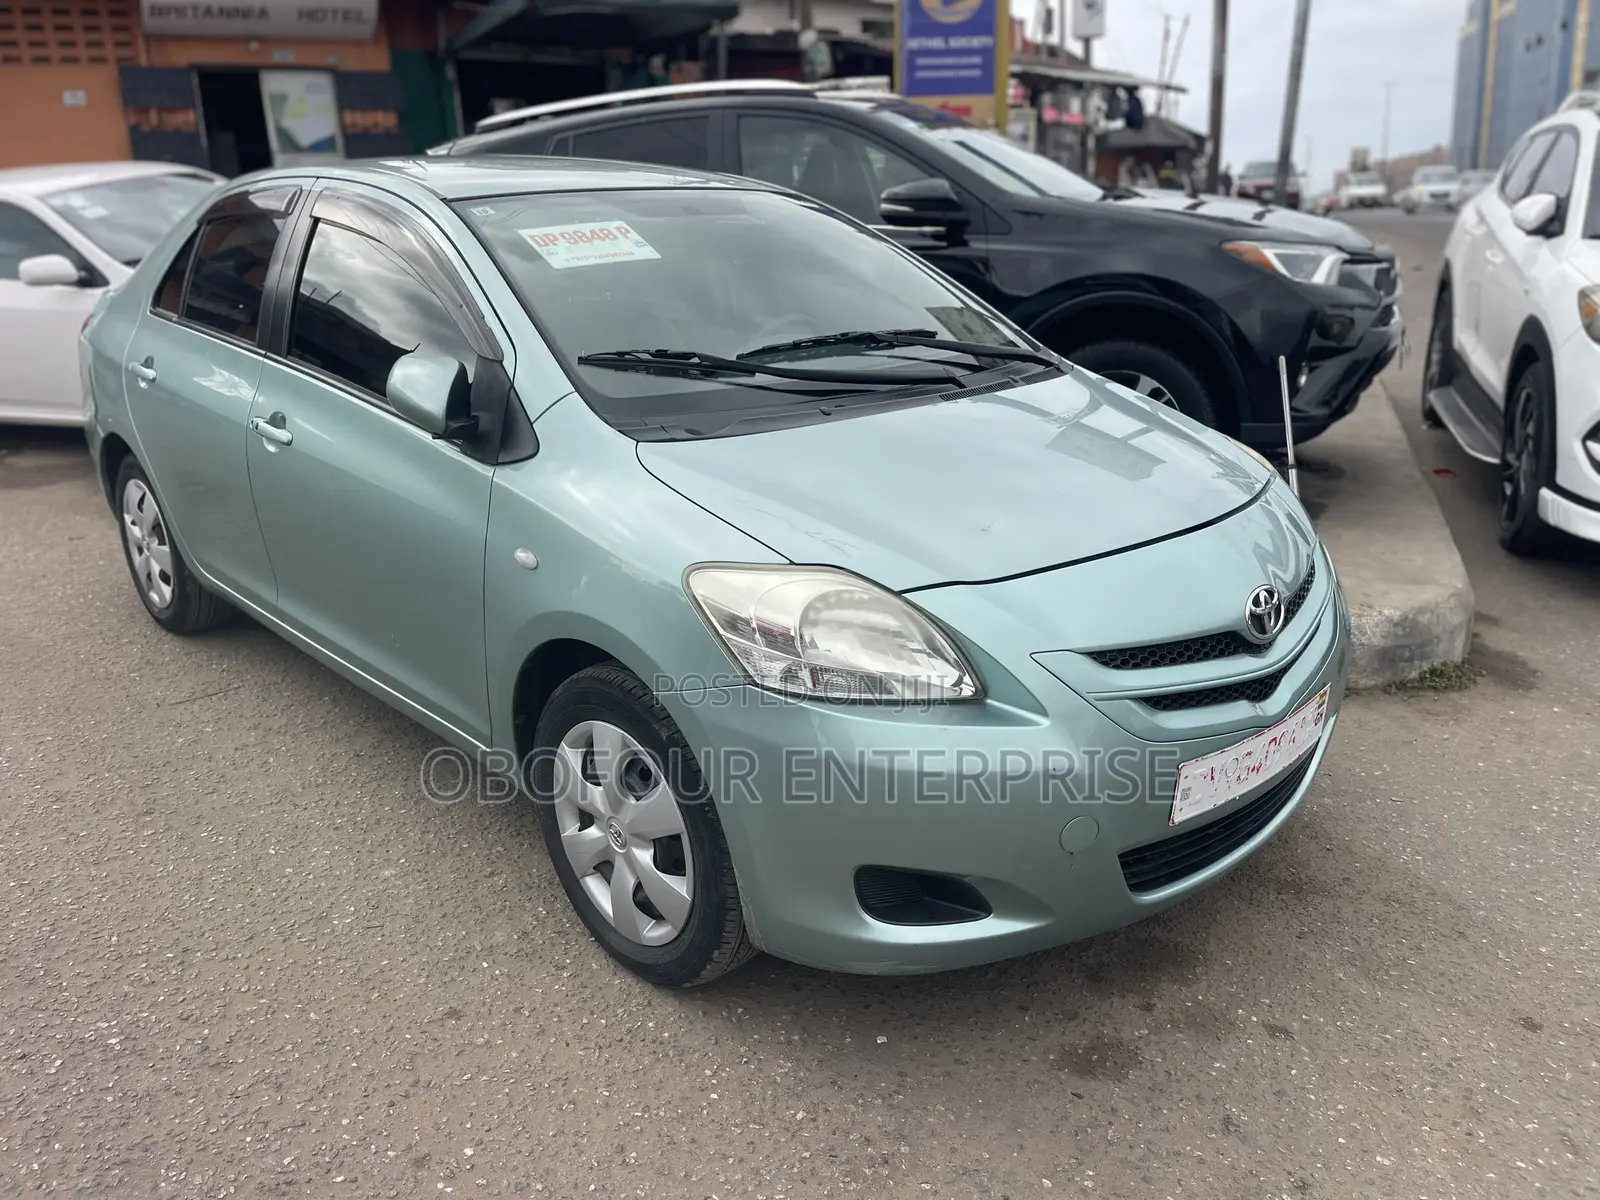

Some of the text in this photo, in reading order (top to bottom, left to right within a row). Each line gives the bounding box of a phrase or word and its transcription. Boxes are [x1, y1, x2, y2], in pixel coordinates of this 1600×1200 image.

[296, 6, 371, 24] HOTEL
[527, 233, 560, 249] DP
[560, 227, 618, 246] 9848
[613, 225, 632, 241] P
